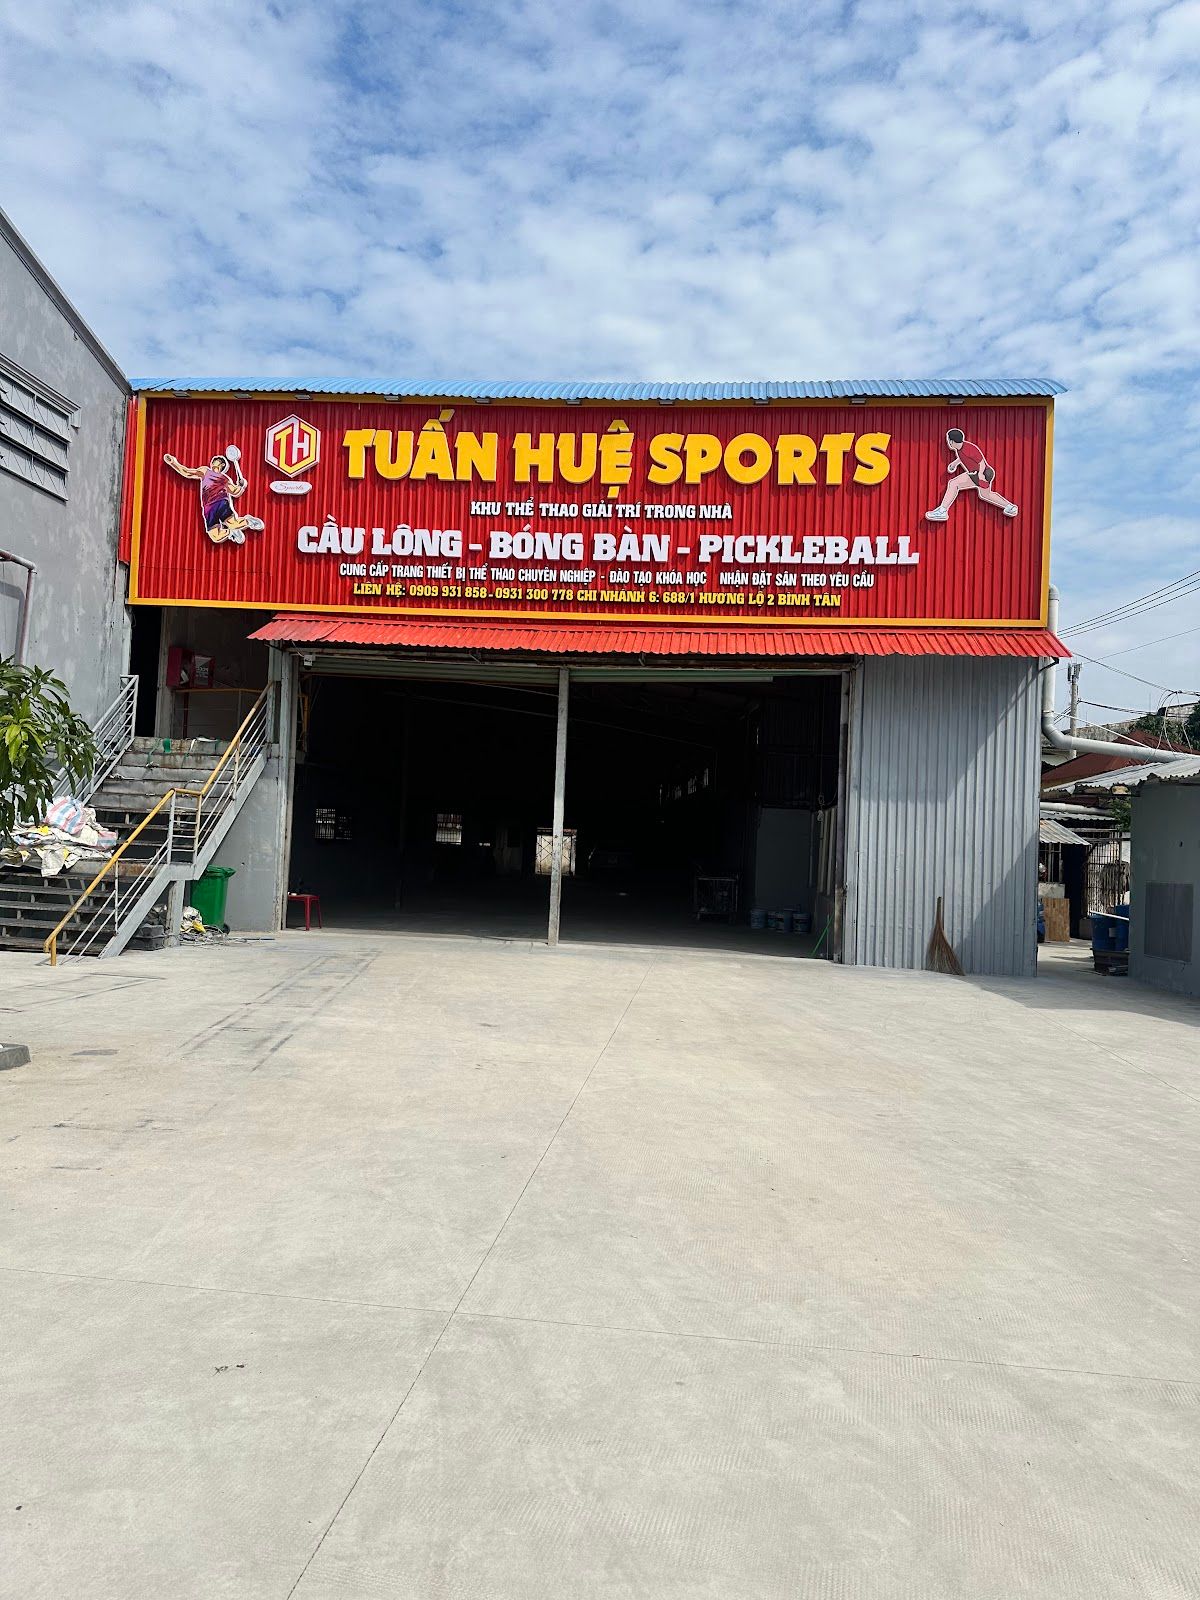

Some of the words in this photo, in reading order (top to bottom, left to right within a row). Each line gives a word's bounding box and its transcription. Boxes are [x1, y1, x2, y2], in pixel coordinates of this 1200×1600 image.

[343, 408, 498, 483] TUẤN
[512, 419, 634, 499] HUỆ
[647, 431, 892, 486] SPORTS
[470, 501, 501, 516] KHU
[505, 497, 534, 516] THỂ
[539, 503, 579, 518] THAO
[582, 500, 612, 518] GIẢI
[616, 502, 642, 518] TRÍ
[645, 505, 696, 519] TRONG
[699, 502, 733, 520] NHÀ
[297, 513, 366, 556] CẦU
[371, 523, 463, 558] LÔNG
[489, 523, 584, 562] BÓNG
[593, 525, 671, 563] BÀN
[698, 534, 920, 566] PICKLEBALL
[339, 563, 367, 577] CUNG
[369, 560, 389, 577] CẤP
[391, 564, 423, 578] TRANG
[426, 562, 453, 579] THIẾT
[455, 567, 466, 581] BỊ
[469, 562, 488, 580] THỂ
[490, 567, 516, 581] THAO
[518, 566, 557, 582] CHUYÊN
[559, 567, 596, 586] NGHIỆP
[609, 568, 630, 583] ĐÀO
[633, 570, 652, 587] TẠO
[655, 569, 683, 585] KHÓA
[686, 571, 707, 587] HỌC
[719, 570, 749, 588] NHẬN
[751, 570, 772, 588] ĐẶT
[800, 573, 826, 587] THEO
[829, 572, 849, 588] YÊU
[852, 570, 875, 588] CẦU
[353, 581, 382, 595] LIÊN
[385, 582, 405, 597] HỆ:
[409, 584, 439, 597] 0909
[441, 585, 462, 597] 931
[526, 588, 548, 600] 300
[551, 589, 574, 601] 778
[576, 590, 598, 602] CHI
[648, 591, 660, 604] 6:
[662, 591, 695, 604] 688/1
[698, 592, 744, 605] HƯƠNG
[767, 594, 774, 606] 2
[777, 592, 810, 606] BÌNH
[813, 592, 841, 607] TÂN
